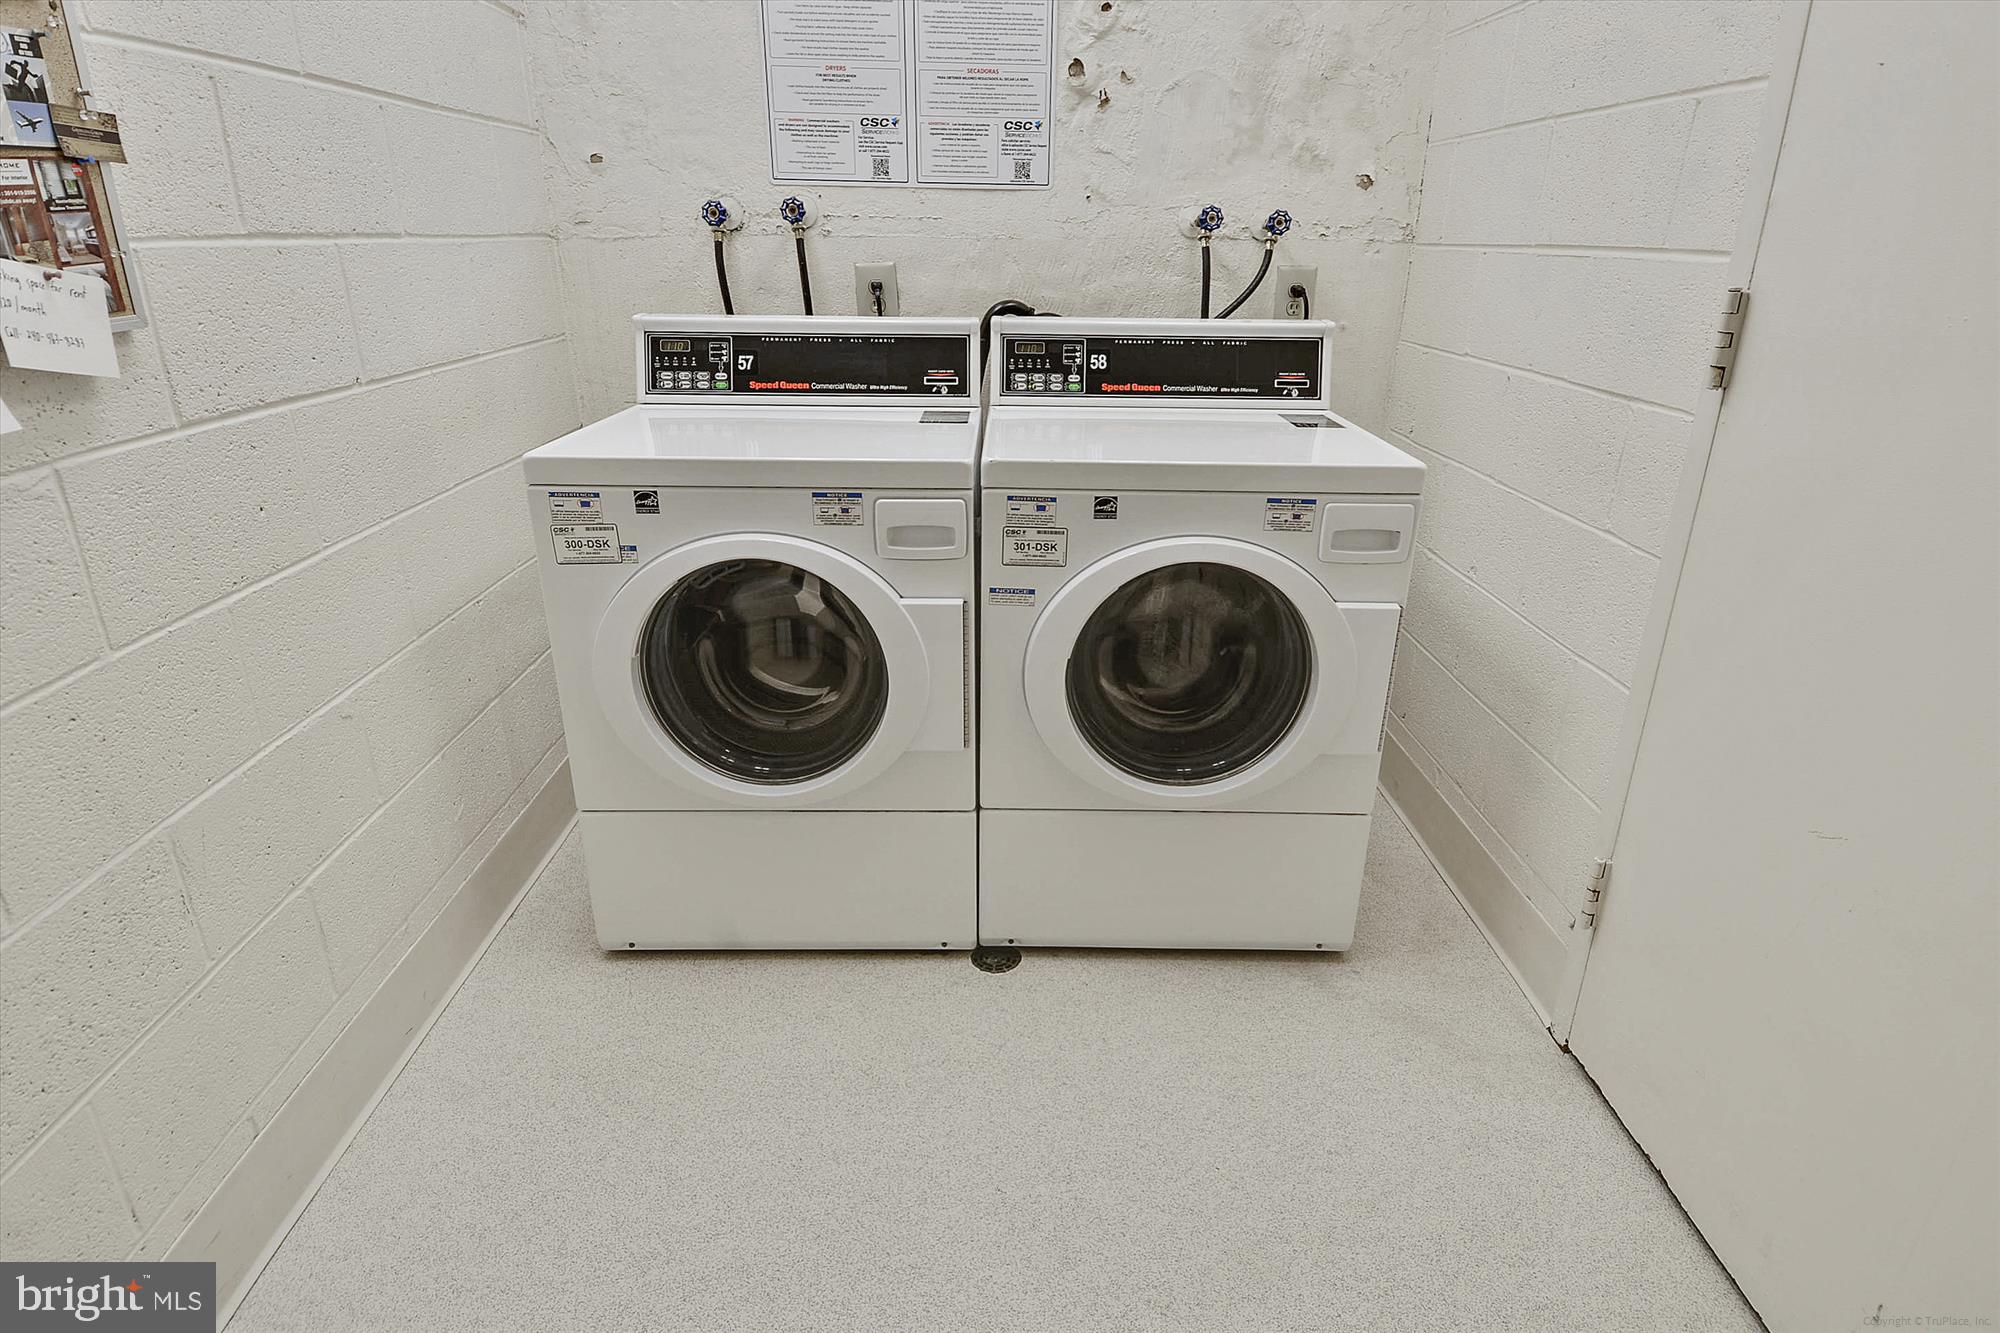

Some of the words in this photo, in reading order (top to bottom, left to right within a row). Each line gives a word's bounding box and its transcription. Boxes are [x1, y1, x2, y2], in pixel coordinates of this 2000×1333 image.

[860, 117, 890, 127] CSC
[1004, 121, 1033, 131] CSC
[737, 355, 754, 371] 57
[1090, 354, 1107, 370] 58
[749, 380, 779, 390] Speed
[780, 380, 810, 390] Queen
[811, 382, 845, 390] Commercial
[845, 382, 868, 390] Washer
[1101, 382, 1131, 392] Speed
[1131, 383, 1161, 392] Queen
[564, 539, 611, 549] 300-DSK
[1013, 542, 1058, 552] 301-DSK
